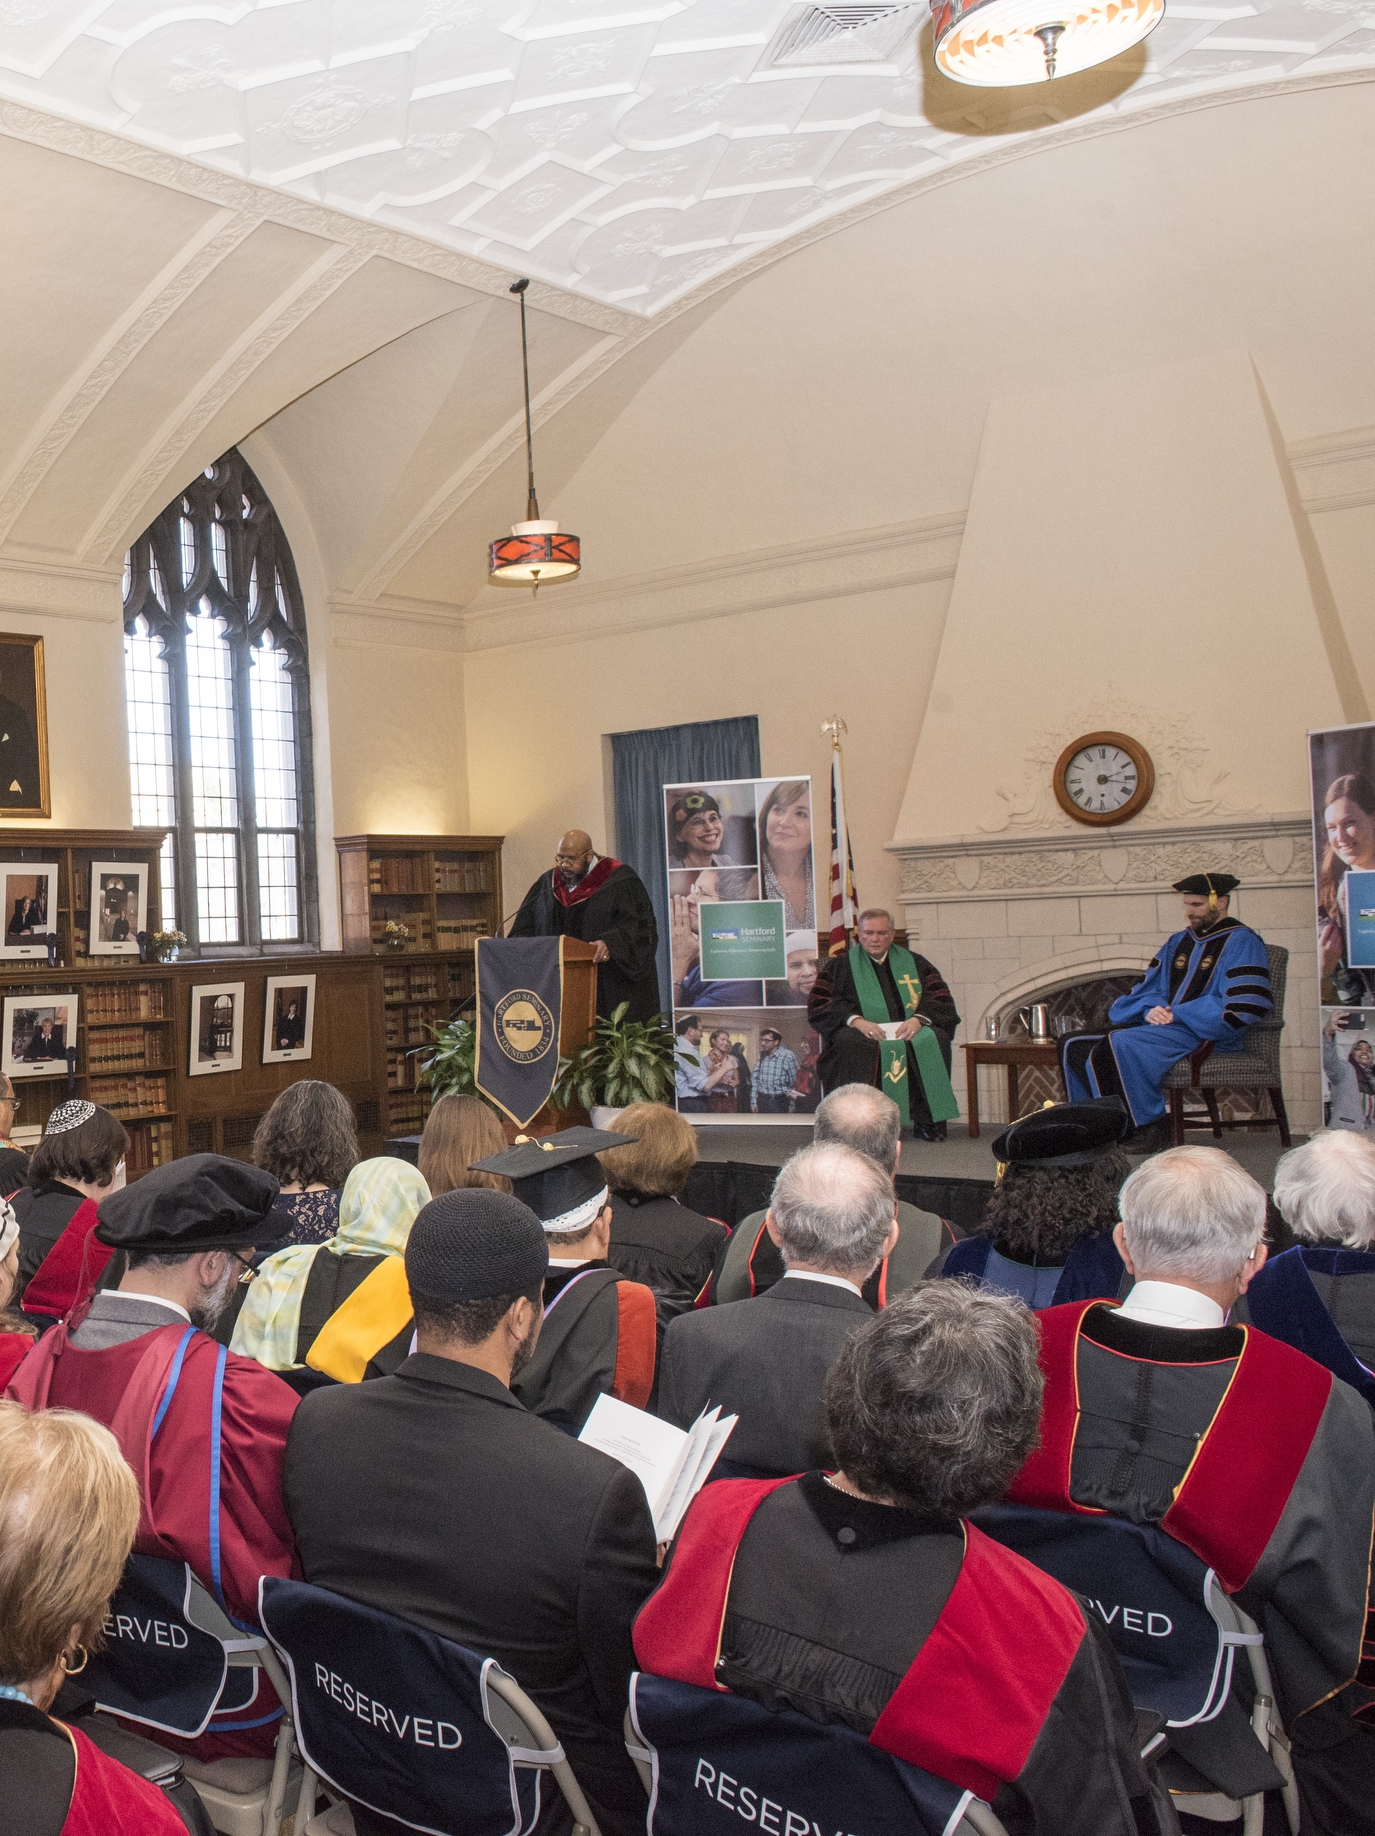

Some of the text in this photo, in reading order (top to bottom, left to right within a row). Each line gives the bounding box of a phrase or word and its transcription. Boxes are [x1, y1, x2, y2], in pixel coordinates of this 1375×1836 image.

[740, 927, 776, 936] Hartford
[740, 935, 776, 943] SEMINARY
[497, 993, 551, 1027] HARTFORD SEMINARY
[499, 1035, 533, 1060] FOUNDED
[101, 1613, 189, 1649] ERVED
[314, 1662, 463, 1750] RESERVED
